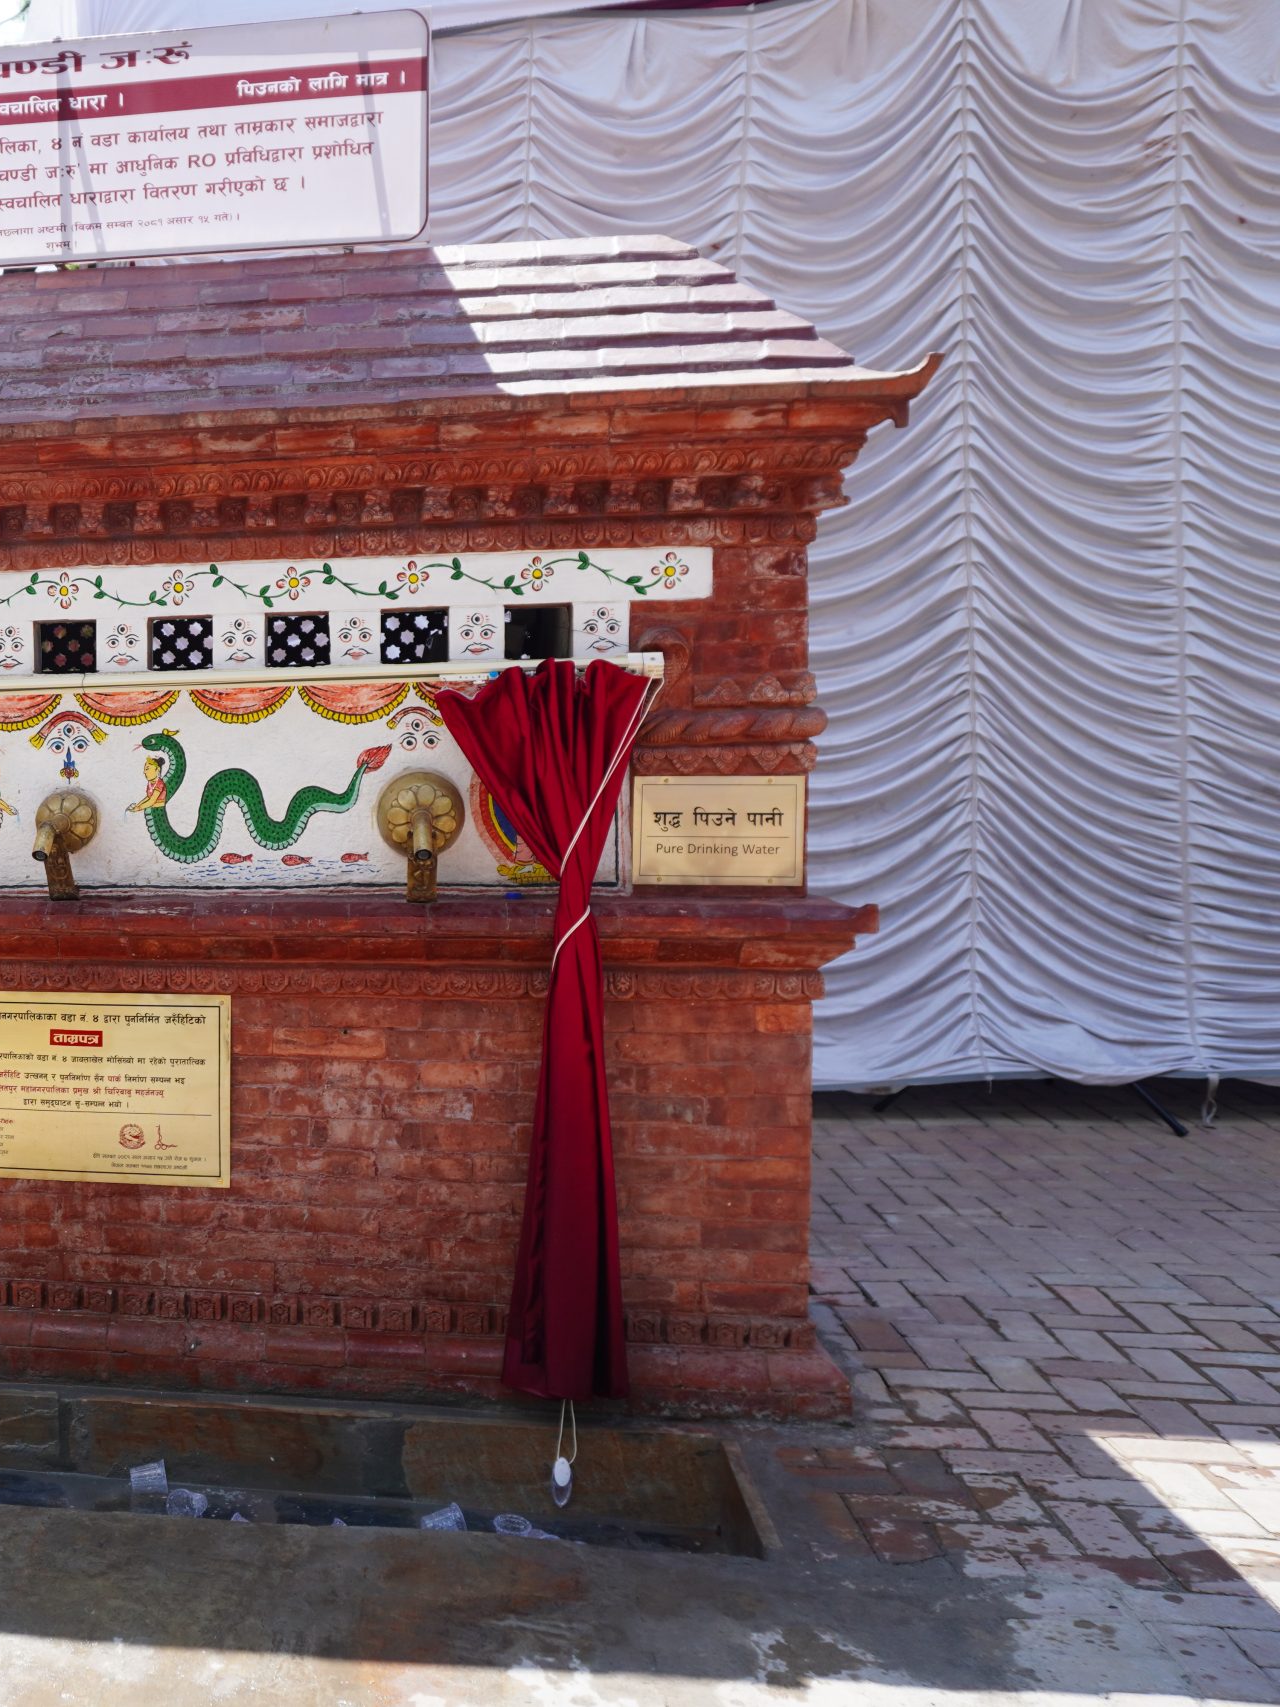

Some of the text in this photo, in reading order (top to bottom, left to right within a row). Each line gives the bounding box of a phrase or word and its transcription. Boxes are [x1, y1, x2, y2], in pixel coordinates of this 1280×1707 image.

[237, 75, 300, 97] पिउनको
[309, 71, 348, 91] लागि
[356, 71, 389, 87] मात्र
[69, 94, 107, 111] धारा
[91, 133, 120, 147] वडा
[128, 125, 189, 144] कार्यालय
[198, 124, 227, 139] तथा
[235, 118, 297, 135] ताम्रकार
[305, 111, 384, 129] समाजद्वारा
[90, 162, 107, 175] मा
[117, 154, 178, 176] आधुनिक
[188, 154, 216, 168] RO
[225, 145, 303, 165] प्रविधिद्वारा
[312, 138, 375, 159] प्रशोधित
[71, 187, 135, 206] धाराद्वारा
[143, 182, 198, 201] वितरण
[206, 175, 266, 196] गरीएको
[273, 177, 289, 192] छ
[37, 222, 67, 234] अष्टमी
[106, 219, 133, 229] सम्वत
[137, 217, 164, 228] २०८१
[167, 215, 194, 226] असार
[653, 806, 784, 832] शुद्ध पिउने पानी
[656, 843, 781, 856] Pure Drinking Water
[60, 1013, 76, 1022] वडा
[103, 1014, 121, 1024] द्वारा
[53, 1033, 99, 1045] ताम्रपत्र
[36, 1054, 49, 1062] वडा
[149, 1057, 167, 1066] रहेको
[73, 1087, 89, 1096] प्रमुख
[93, 1086, 102, 1095] श्री
[23, 1098, 37, 1106] द्वारा
